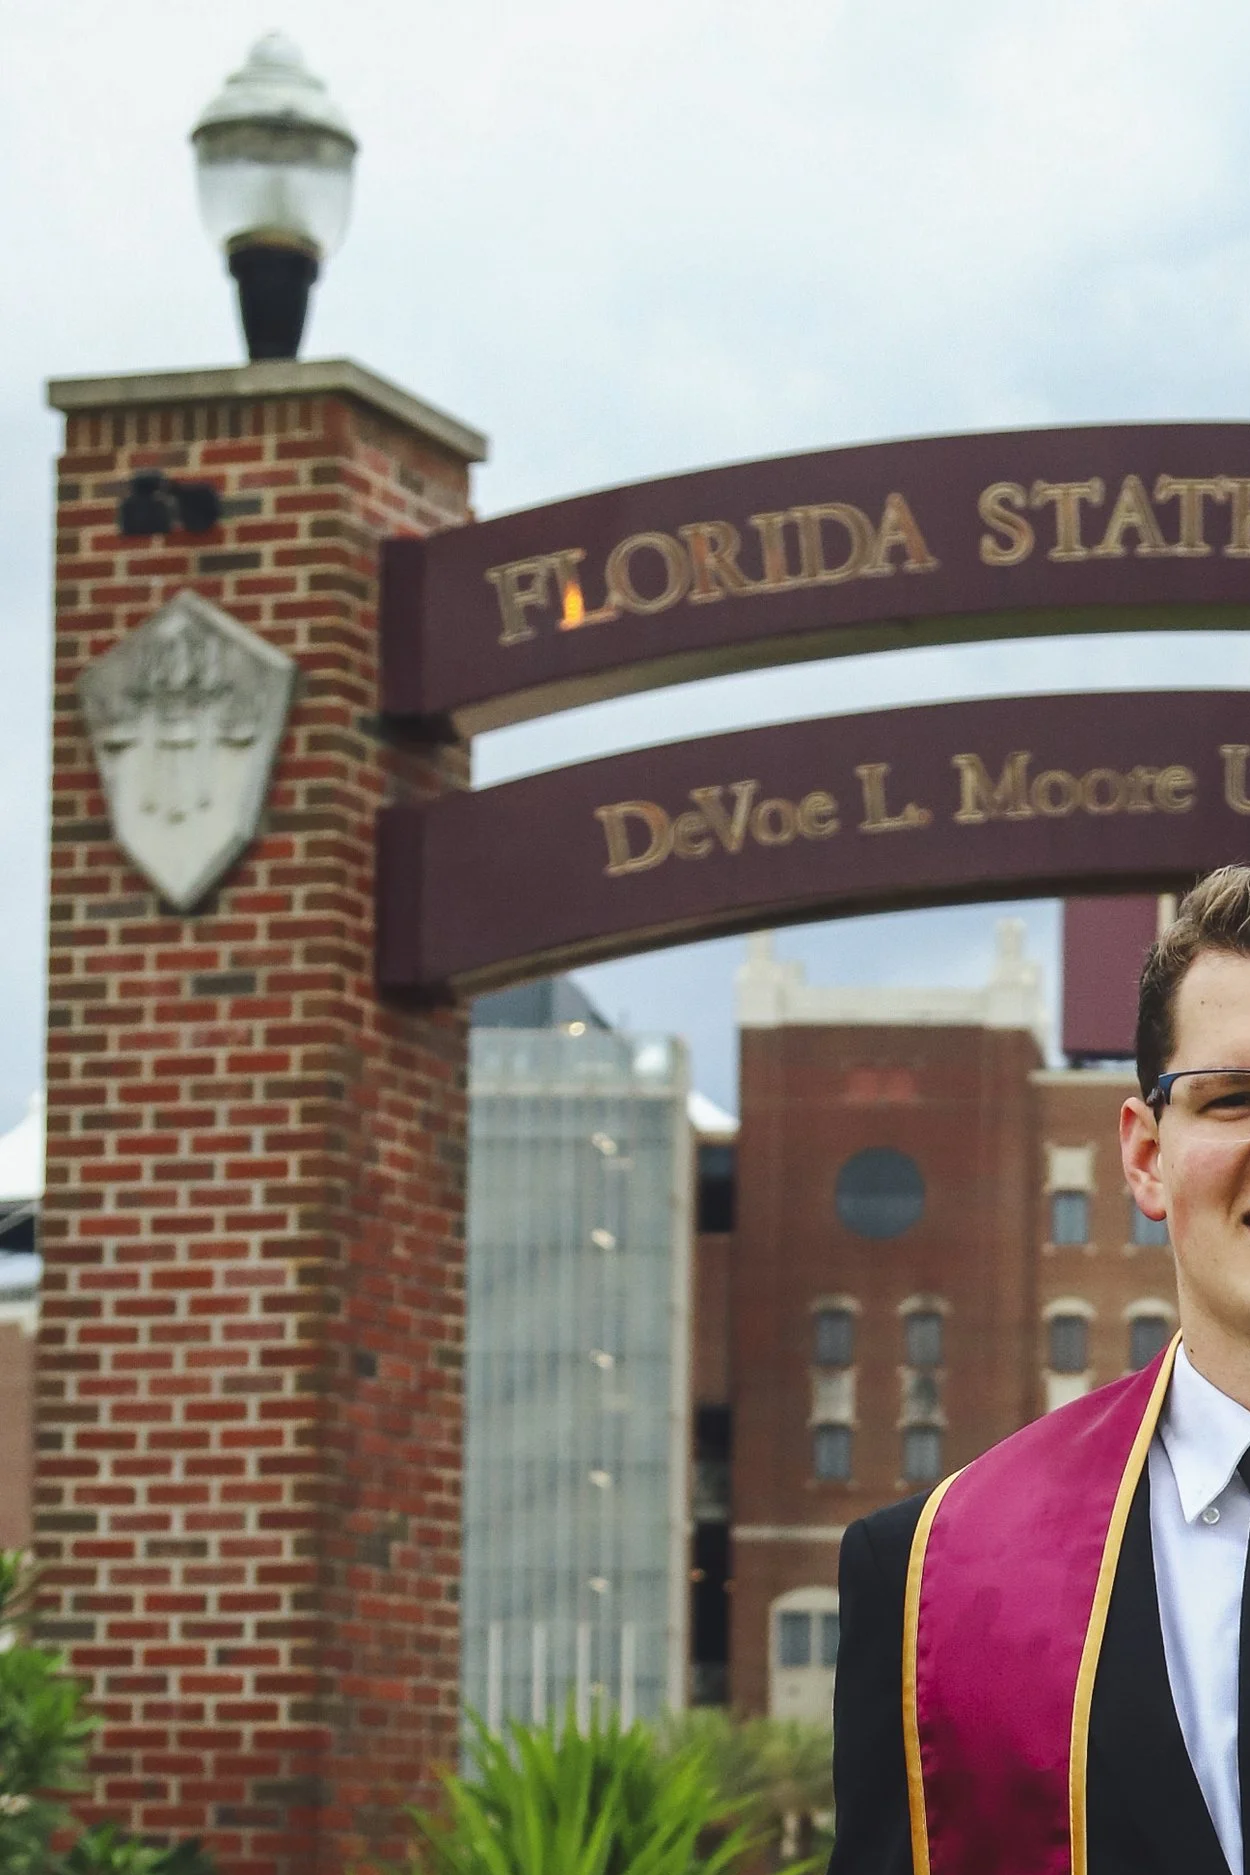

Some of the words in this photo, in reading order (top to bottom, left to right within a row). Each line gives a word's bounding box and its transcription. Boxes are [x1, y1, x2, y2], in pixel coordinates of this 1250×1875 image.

[485, 492, 941, 647] FLORIDA
[596, 779, 842, 876] DeVoe
[853, 762, 934, 834] L.
[951, 749, 1198, 826] Moore
